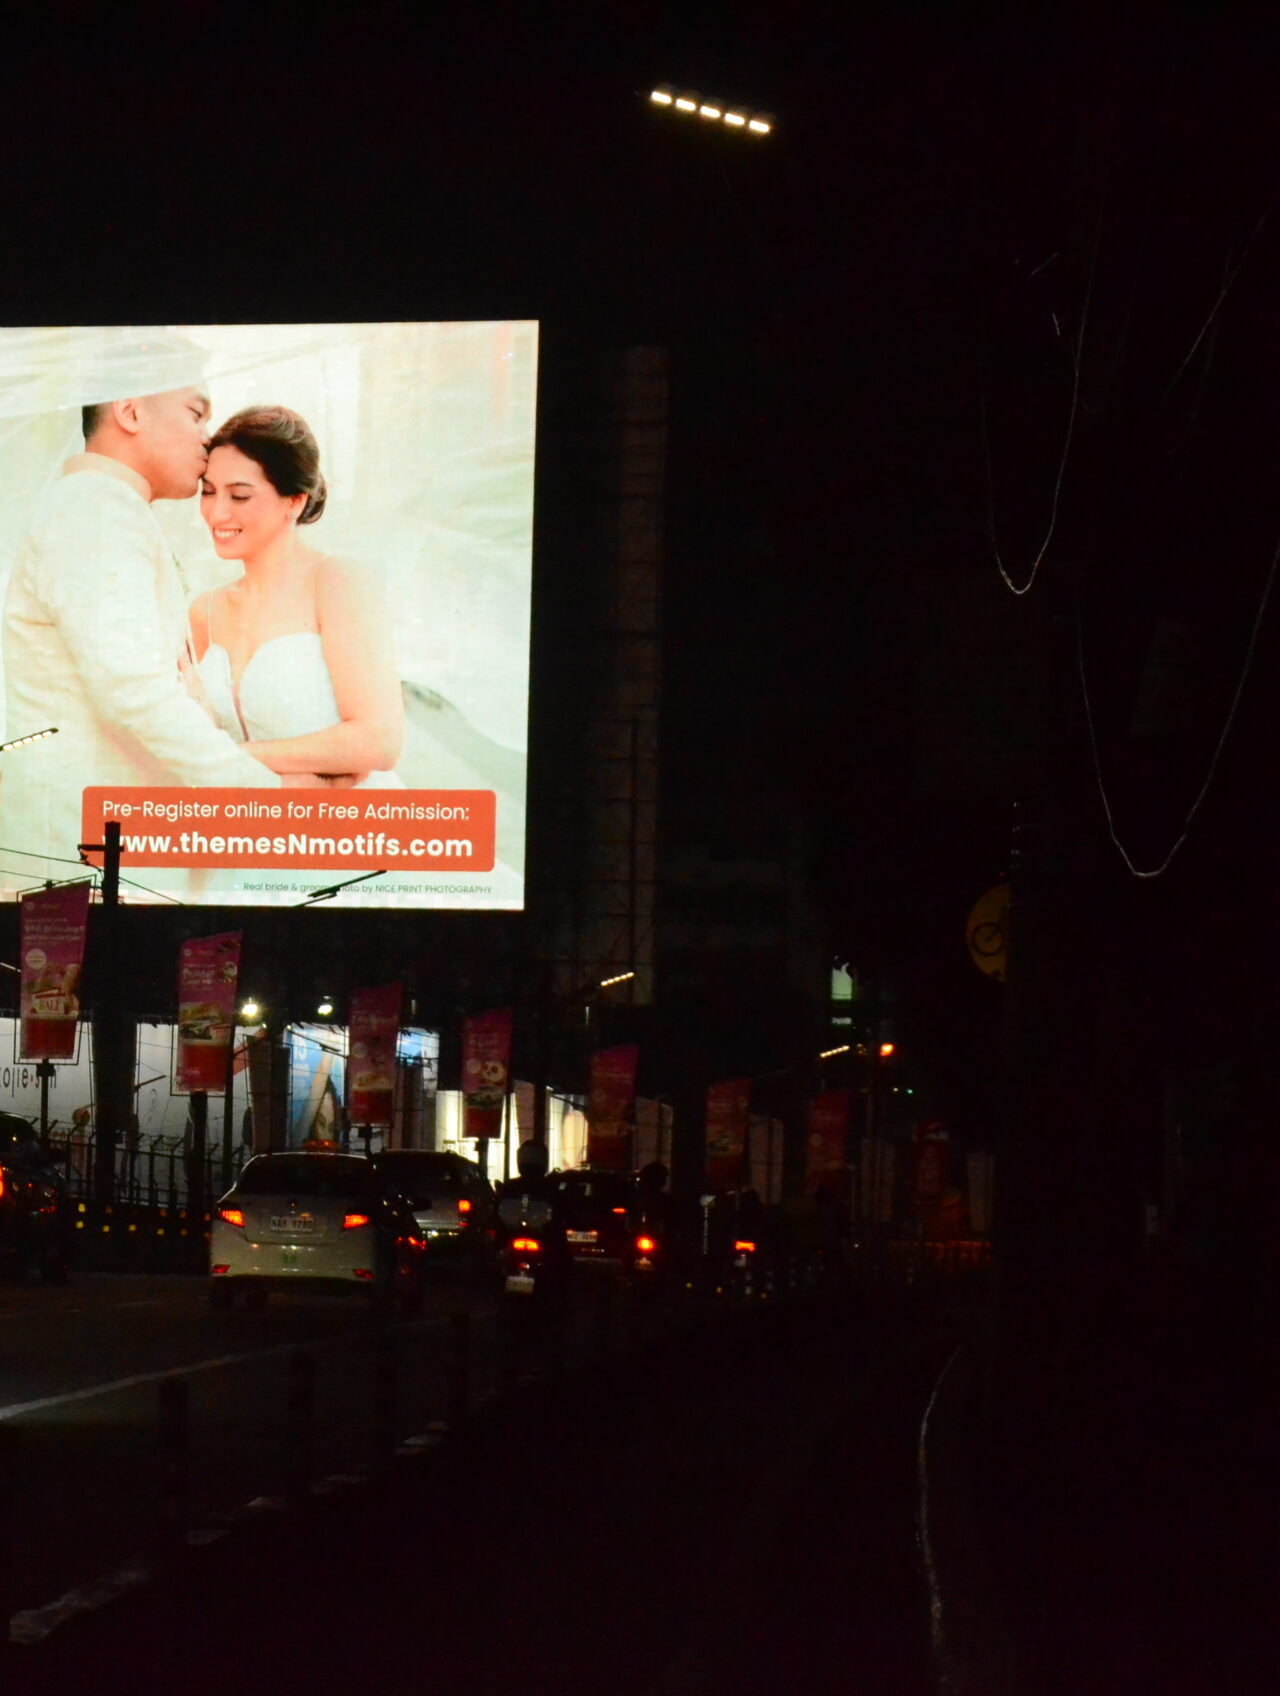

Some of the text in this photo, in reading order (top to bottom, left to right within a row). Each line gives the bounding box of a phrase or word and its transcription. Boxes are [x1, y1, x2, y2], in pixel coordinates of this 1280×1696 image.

[102, 800, 470, 821] Pre-Register online for Free Admission:
[243, 882, 263, 892] Real
[265, 882, 289, 892] bride
[362, 884, 373, 895] by
[375, 884, 396, 893] NICE
[398, 885, 422, 893] PRINT
[425, 885, 492, 894] PHOTOGRAPHY
